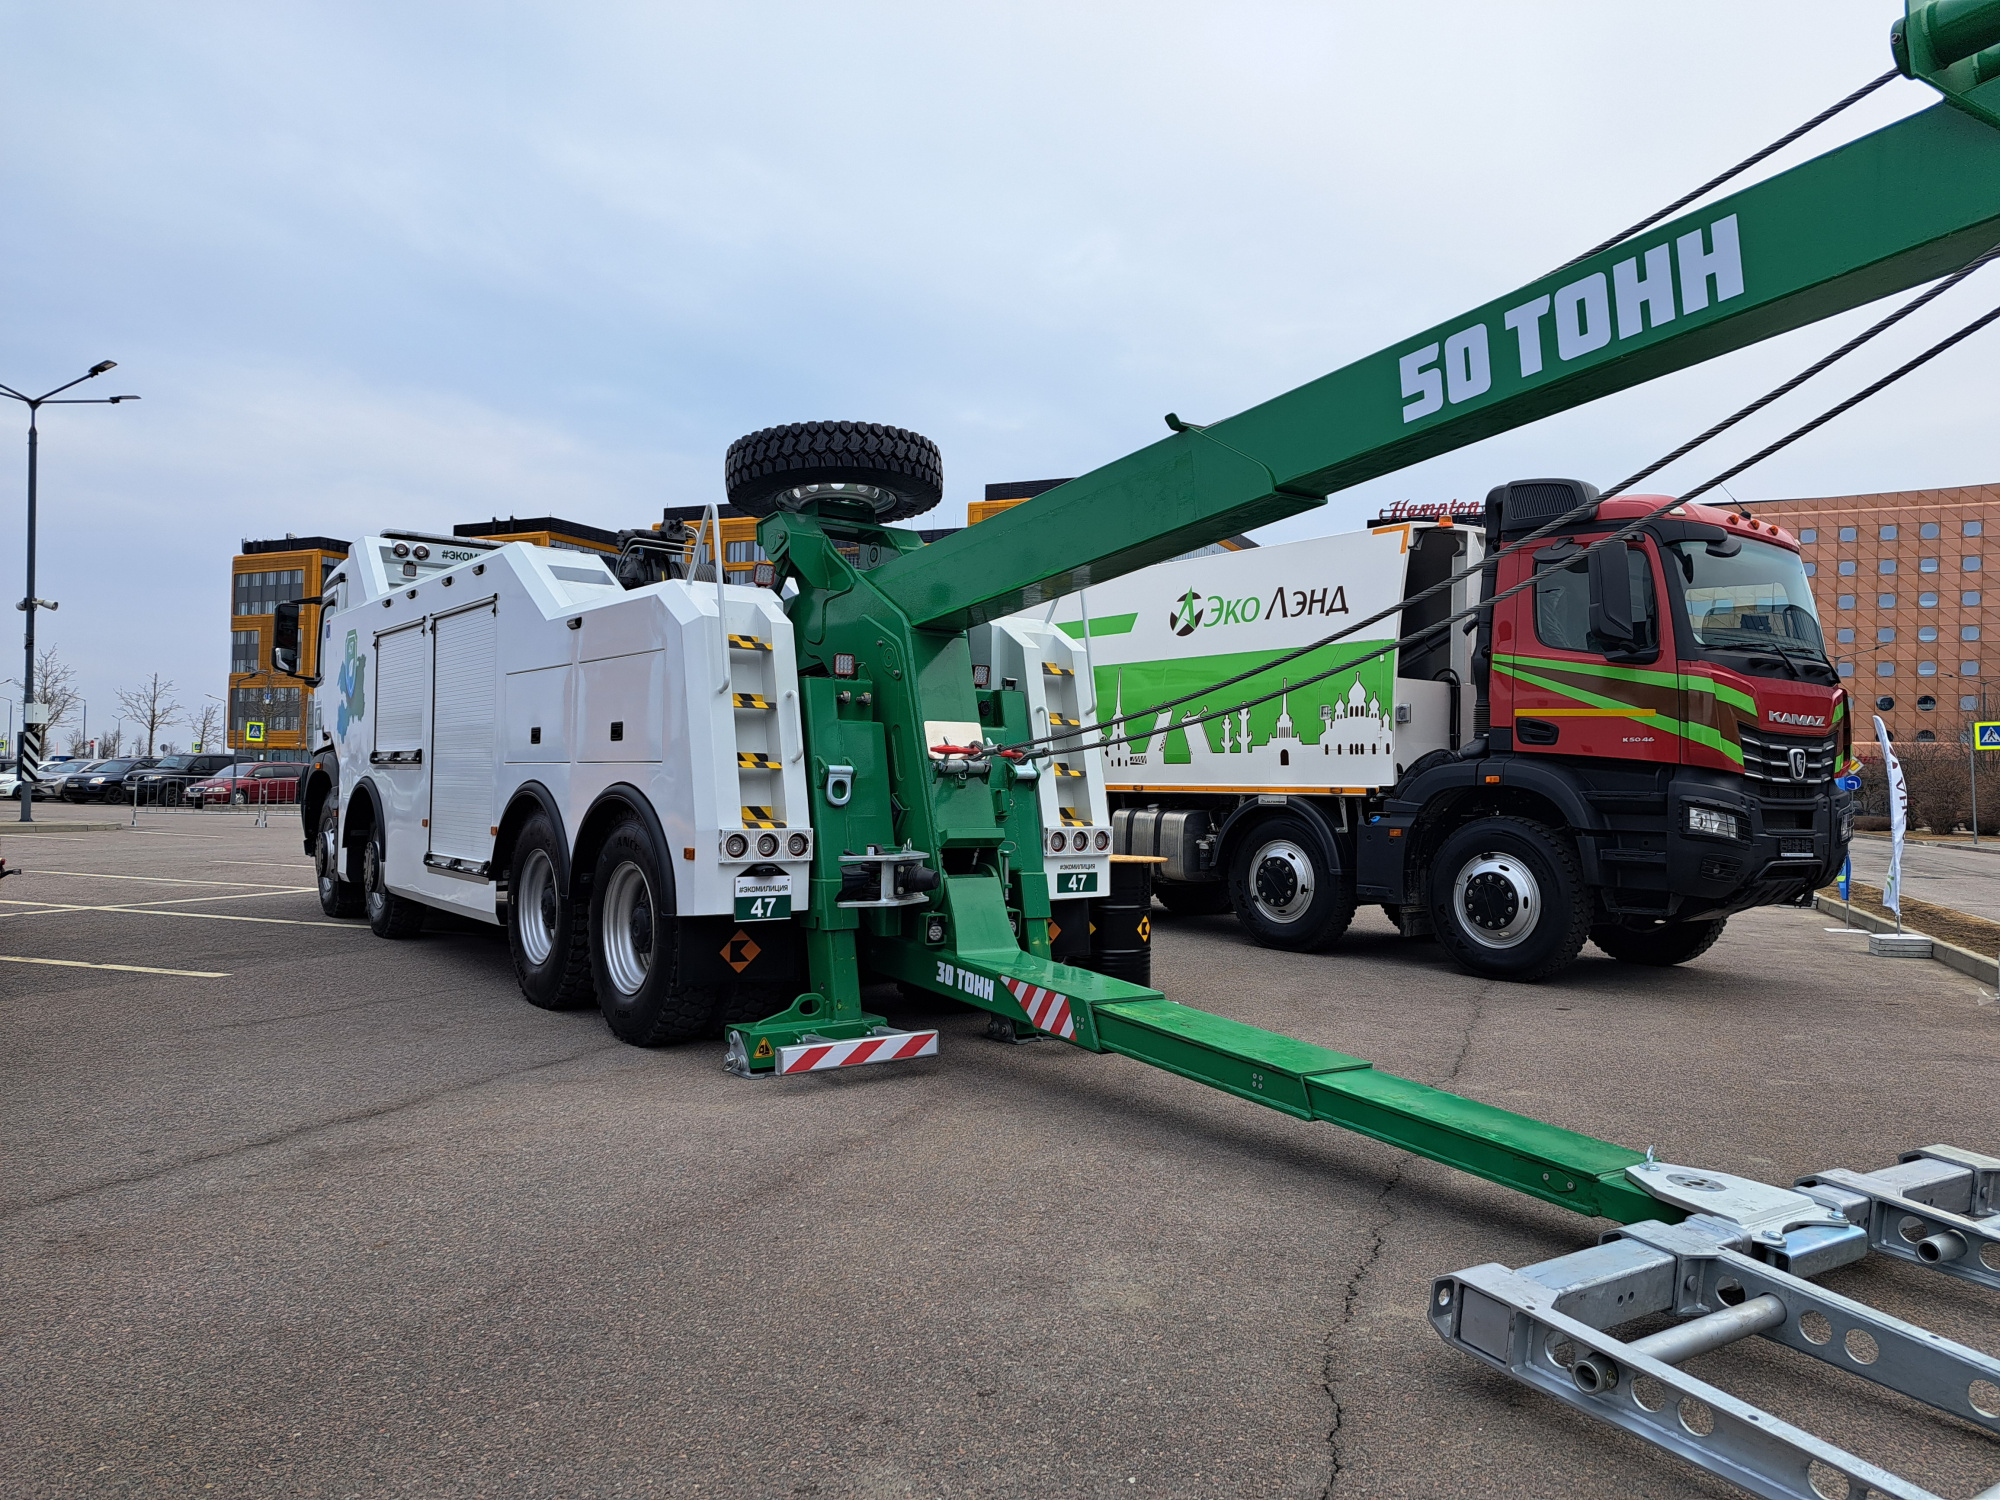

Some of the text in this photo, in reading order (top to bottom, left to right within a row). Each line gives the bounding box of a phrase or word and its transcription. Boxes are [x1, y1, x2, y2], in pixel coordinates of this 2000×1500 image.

[1399, 212, 1745, 424] 50 ТОНН
[1379, 498, 1486, 524] Hampton
[441, 550, 482, 561] #ЭКОМ
[1203, 585, 1349, 628] Эко Лэнд
[1768, 710, 1826, 727] KAMAZ
[739, 884, 788, 894] #ЭКОМИЛИЦИЯ
[1068, 874, 1087, 891] 47
[750, 897, 777, 918] 47
[936, 960, 995, 1002] 30 ТОНН
